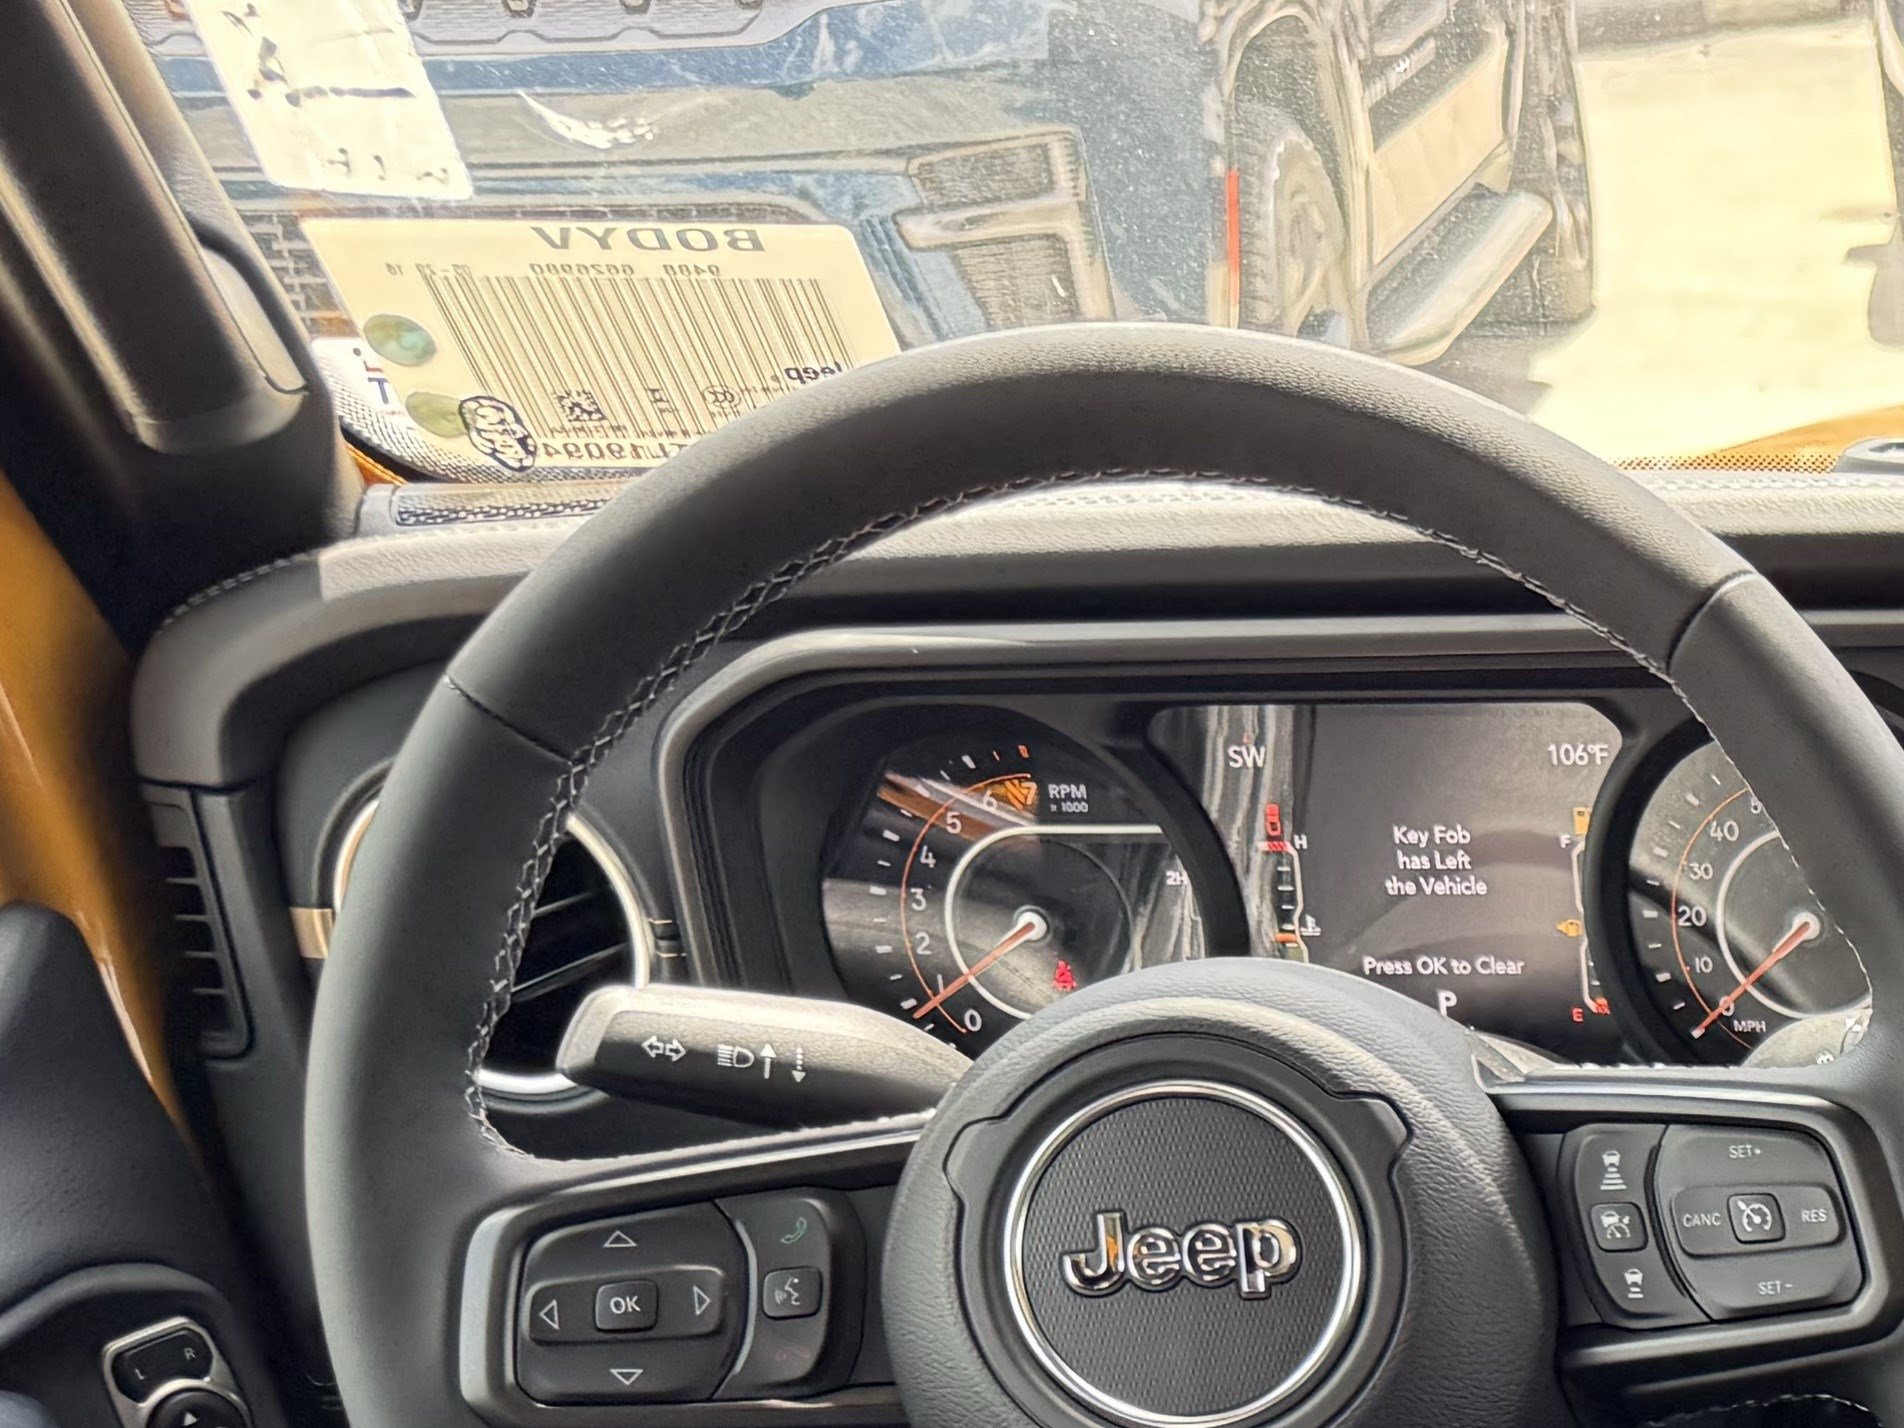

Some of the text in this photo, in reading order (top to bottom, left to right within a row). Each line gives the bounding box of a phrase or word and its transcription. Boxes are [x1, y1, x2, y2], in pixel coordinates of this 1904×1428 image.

[1227, 746, 1267, 769] SW
[982, 790, 998, 809] 6
[1047, 783, 1088, 800] RPM
[1061, 801, 1089, 814] 1000
[946, 811, 963, 834] 5
[1709, 820, 1740, 842] 40
[1294, 835, 1309, 850] H
[1393, 824, 1472, 848] Key Fob
[1559, 834, 1572, 849] F
[919, 846, 937, 868] 4
[1397, 849, 1472, 871] has Left
[1687, 862, 1714, 881] 30
[1385, 876, 1488, 897] the Vehicle
[910, 887, 927, 911] 3
[1676, 904, 1709, 928] 20
[914, 931, 932, 955] 2
[1362, 956, 1526, 976] Press OK to Clear
[1693, 955, 1714, 974] 10
[1436, 988, 1458, 1018] P
[964, 1009, 983, 1032] 0
[1571, 1007, 1585, 1024] E
[1733, 1018, 1767, 1034] MPH
[1682, 1212, 1722, 1228] CANC
[1801, 1208, 1828, 1223] RES
[1061, 1210, 1303, 1299] Jeep
[609, 1295, 642, 1315] OK
[183, 1346, 197, 1360] R
